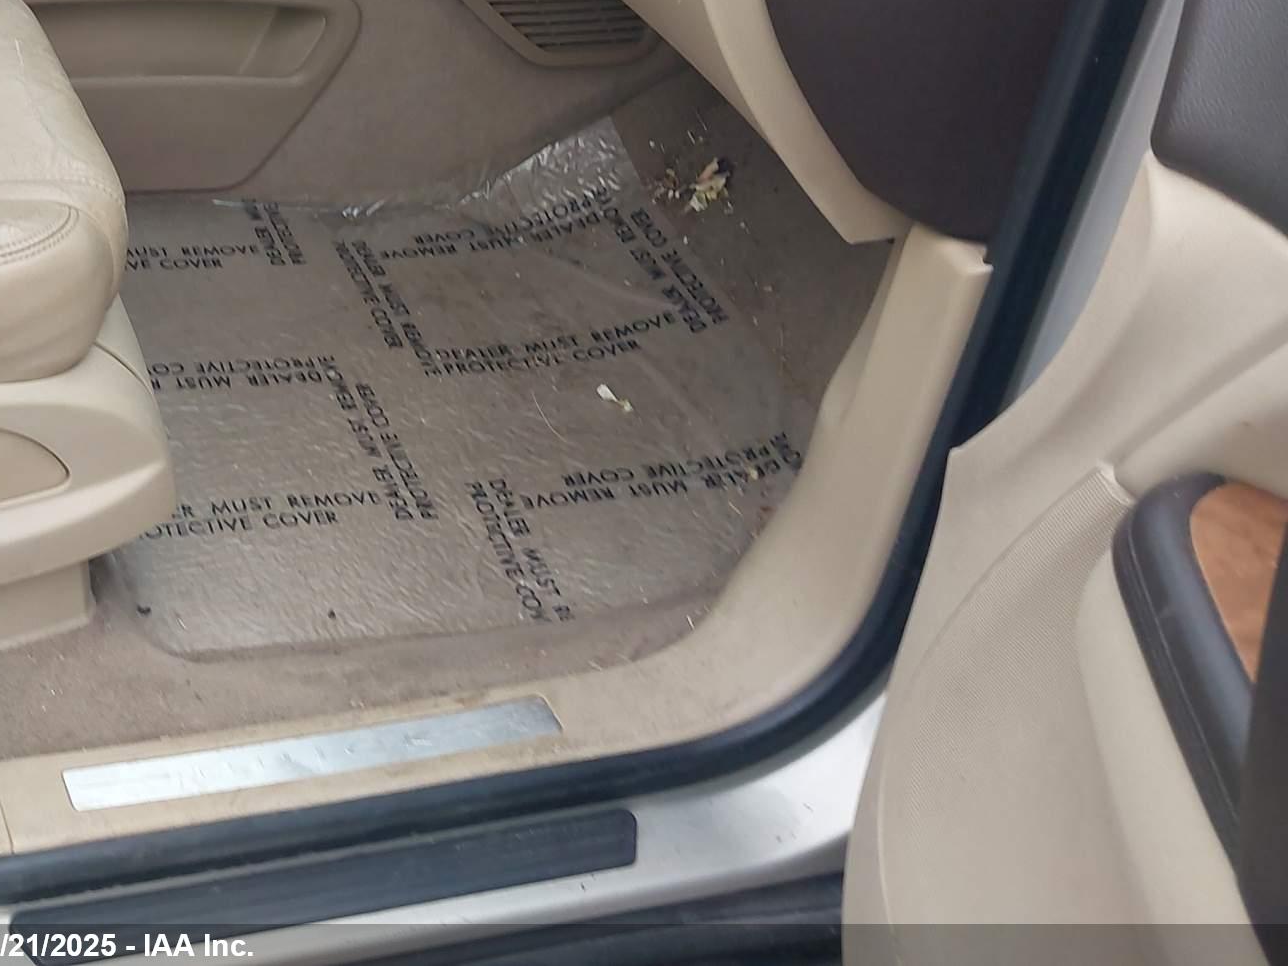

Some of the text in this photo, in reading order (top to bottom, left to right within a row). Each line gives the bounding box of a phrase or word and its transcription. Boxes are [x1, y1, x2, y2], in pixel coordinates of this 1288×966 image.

[415, 230, 475, 245] COVER
[180, 244, 261, 256] REMOVE
[381, 245, 457, 259] REMOVE
[159, 257, 224, 270] COVER
[436, 312, 677, 360] DEALER MUST REMOVE
[573, 339, 641, 361] COVER
[198, 357, 314, 375] PROTECTIVE
[175, 376, 232, 389] MUST
[245, 370, 323, 387] DEALER
[562, 444, 770, 487] PROTECTIVE COVER
[521, 487, 616, 510] REMOVE
[629, 480, 688, 499] MUST
[211, 497, 273, 515] MUST
[286, 490, 381, 508] REMOVE
[144, 511, 339, 540] OTECTIVE COVER
